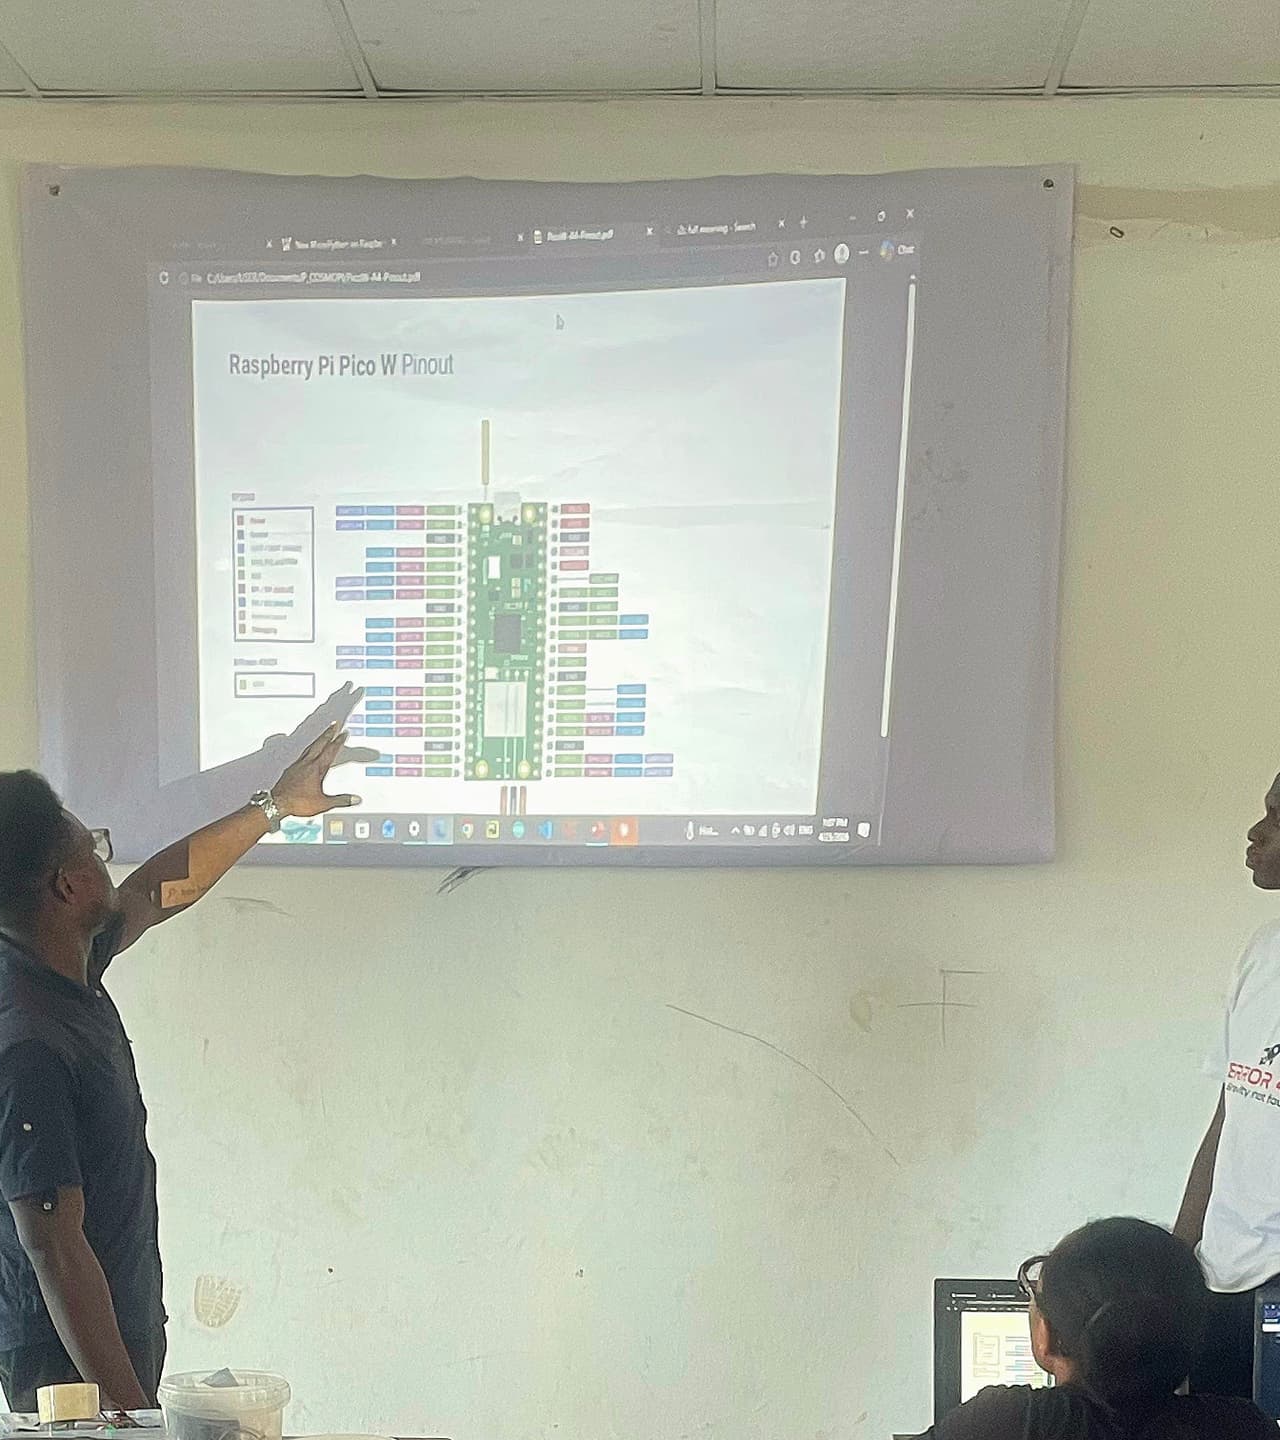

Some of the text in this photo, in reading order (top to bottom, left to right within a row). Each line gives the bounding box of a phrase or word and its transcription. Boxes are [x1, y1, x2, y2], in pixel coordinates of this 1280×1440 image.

[229, 353, 454, 380] Raspberry Pi Pico W Pinout
[1228, 1062, 1273, 1089] ERROR
